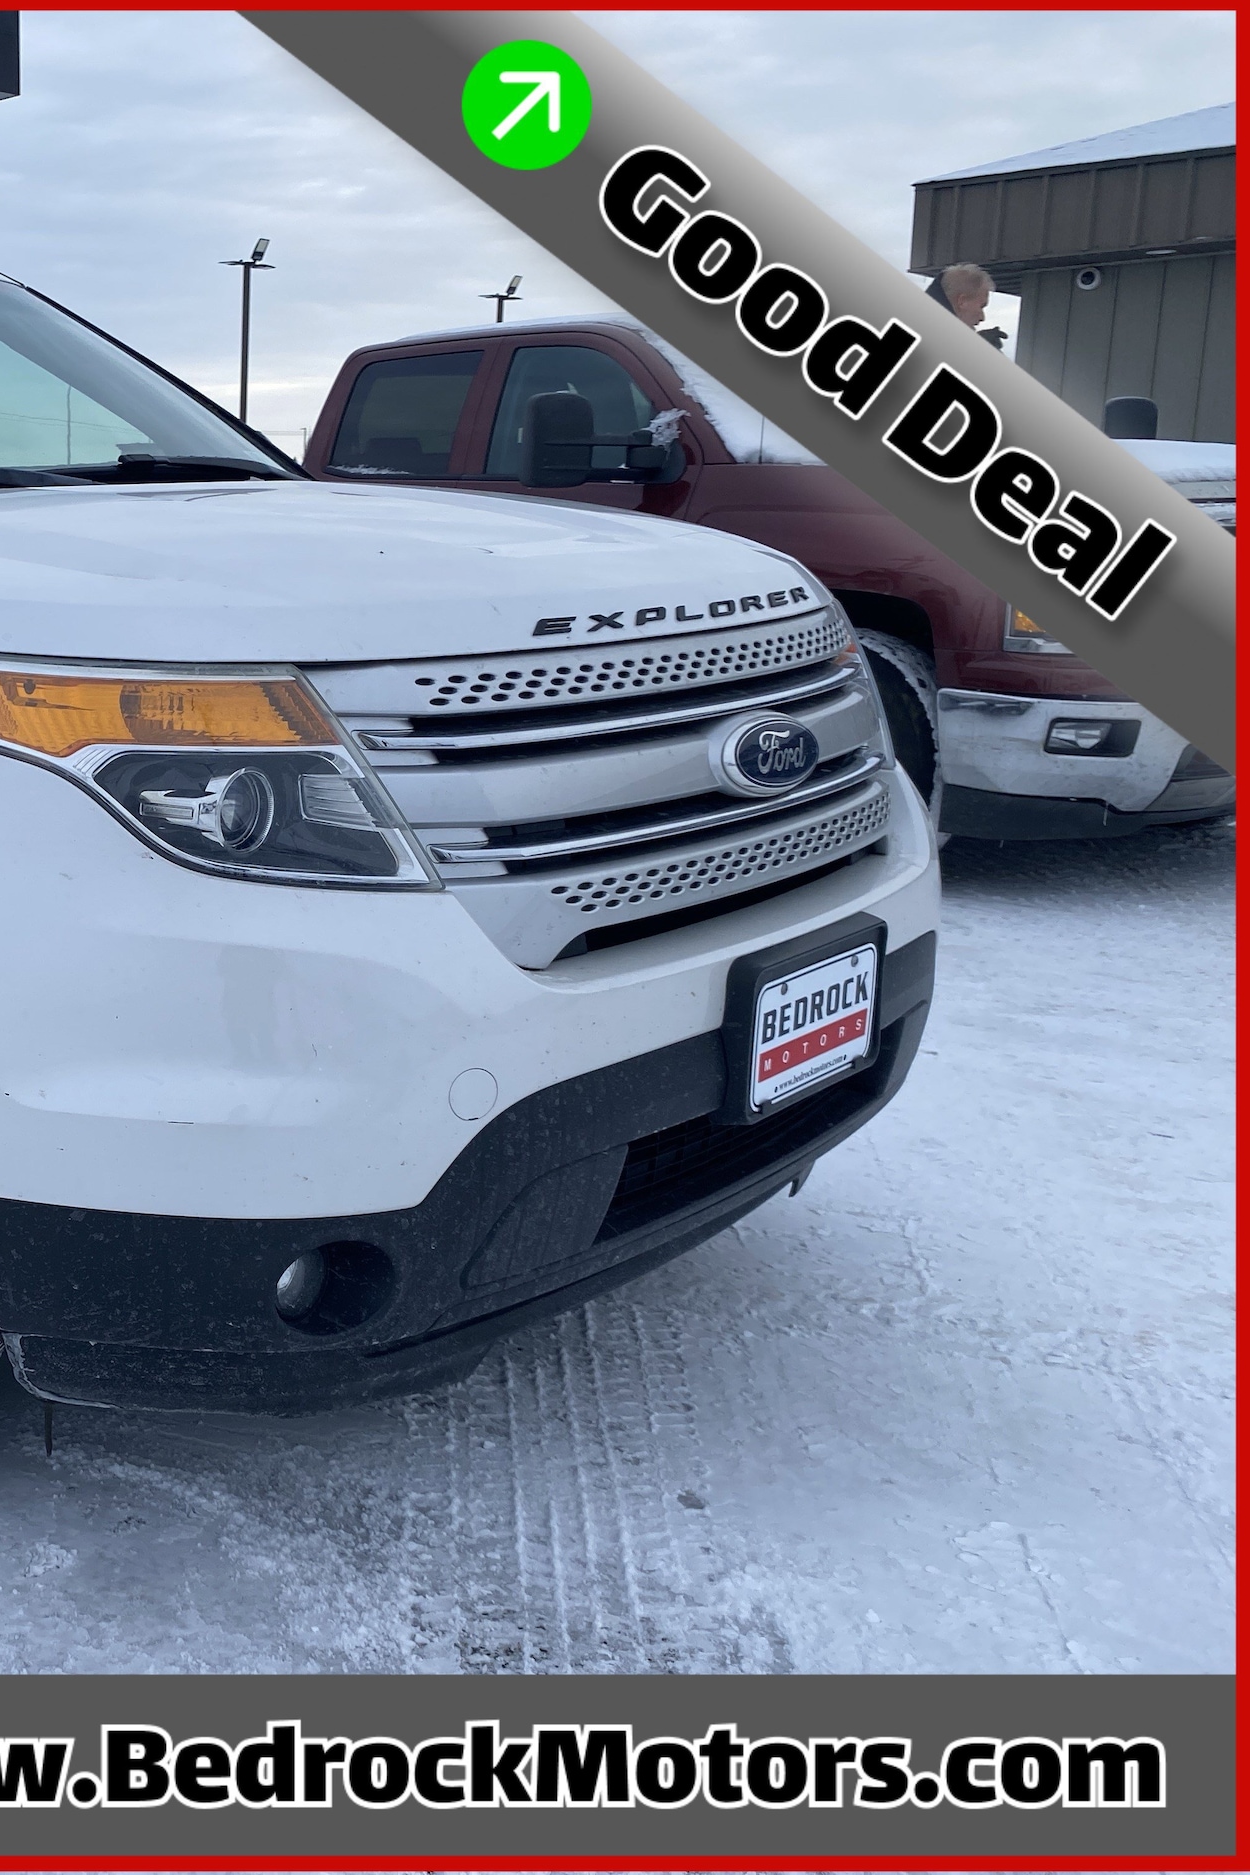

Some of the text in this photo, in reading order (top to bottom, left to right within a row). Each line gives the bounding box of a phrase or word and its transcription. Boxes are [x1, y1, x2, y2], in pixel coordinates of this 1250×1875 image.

[533, 586, 810, 636] EXPLORER
[757, 729, 807, 775] Ford
[762, 971, 869, 1044] BEDROCK
[764, 1018, 863, 1072] MOTORS
[778, 1056, 844, 1091] www.bedrockmotors.com
